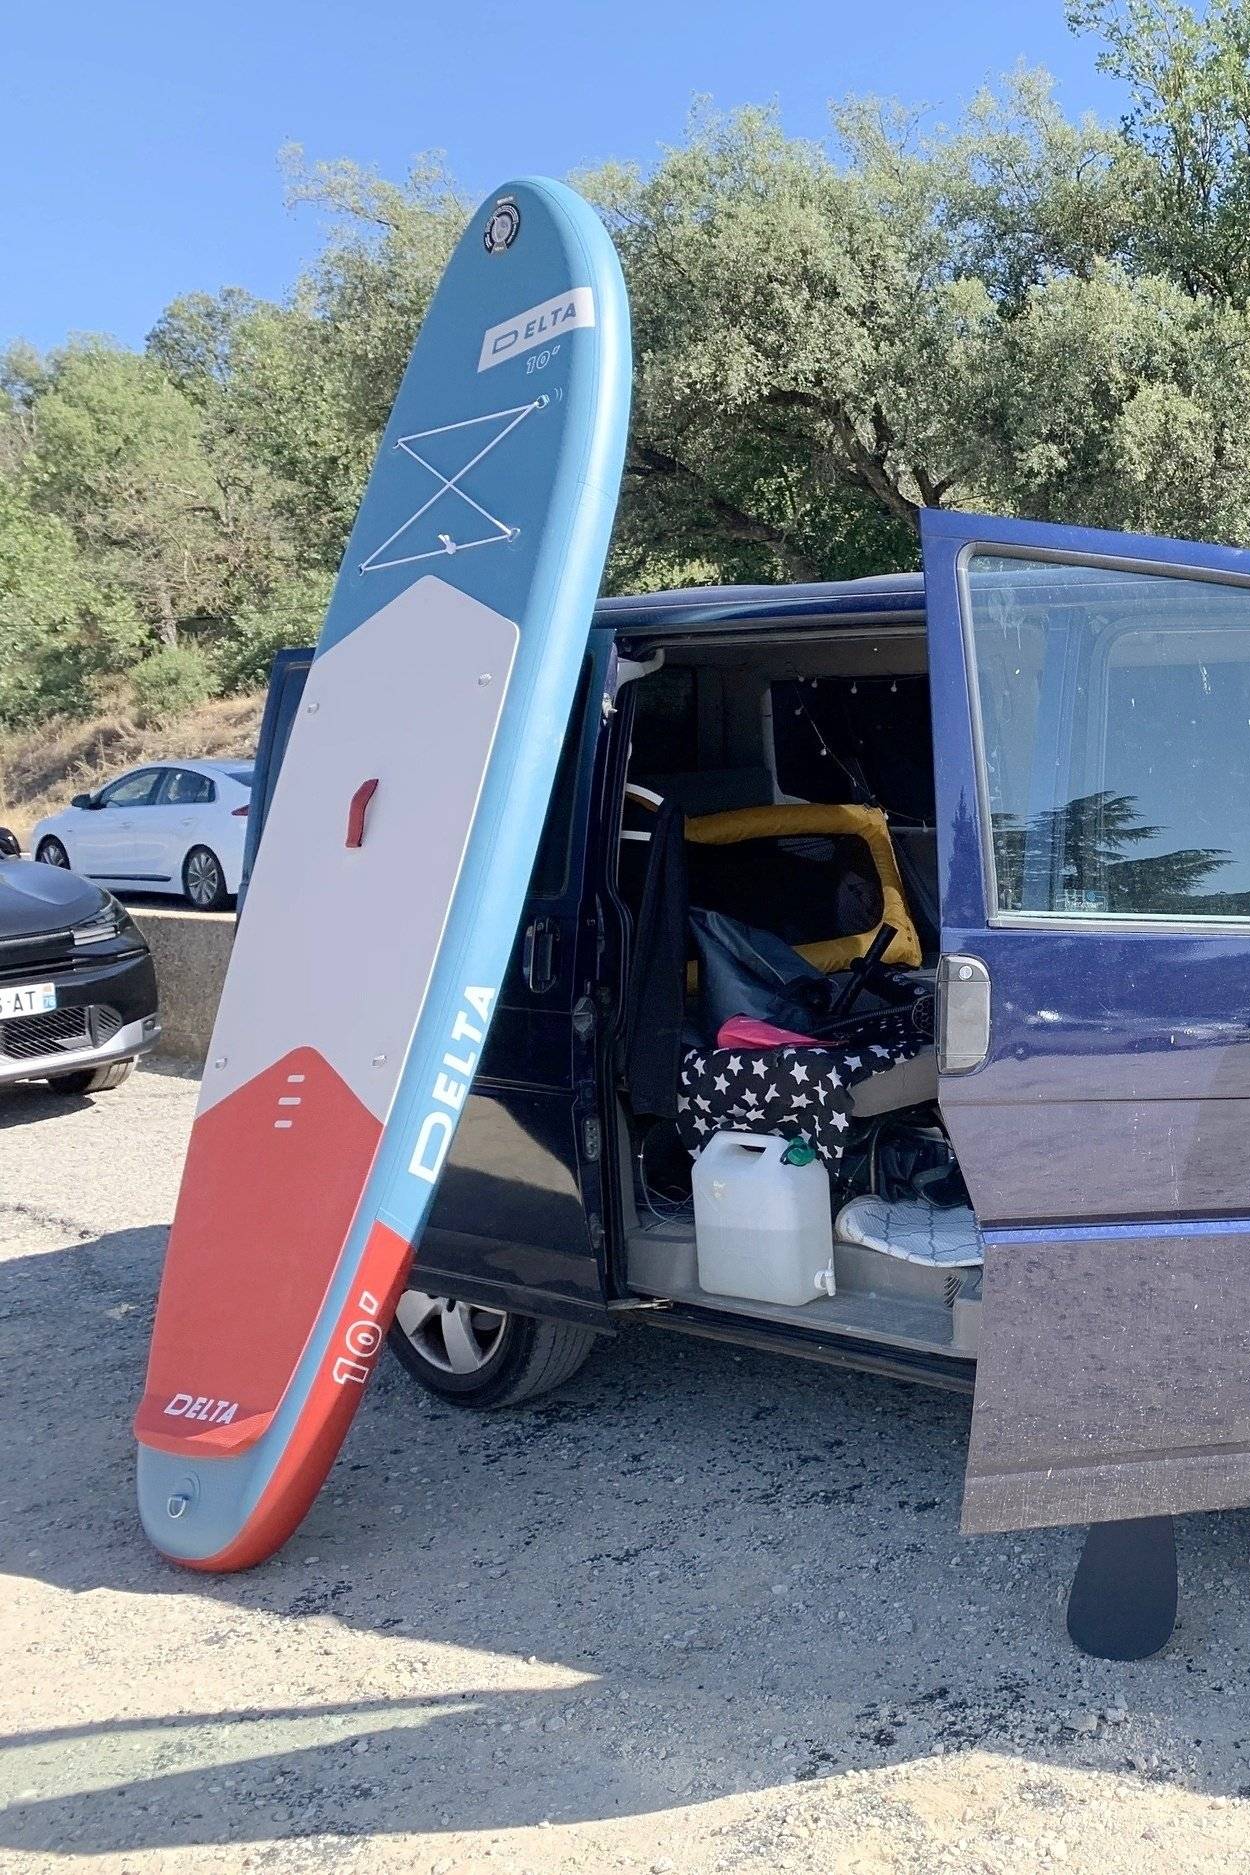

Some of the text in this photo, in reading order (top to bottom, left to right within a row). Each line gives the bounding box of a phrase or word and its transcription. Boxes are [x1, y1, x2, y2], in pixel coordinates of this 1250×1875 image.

[493, 302, 577, 354] DELTA
[408, 985, 497, 1185] DELTA
[164, 1393, 240, 1424] DELTA
